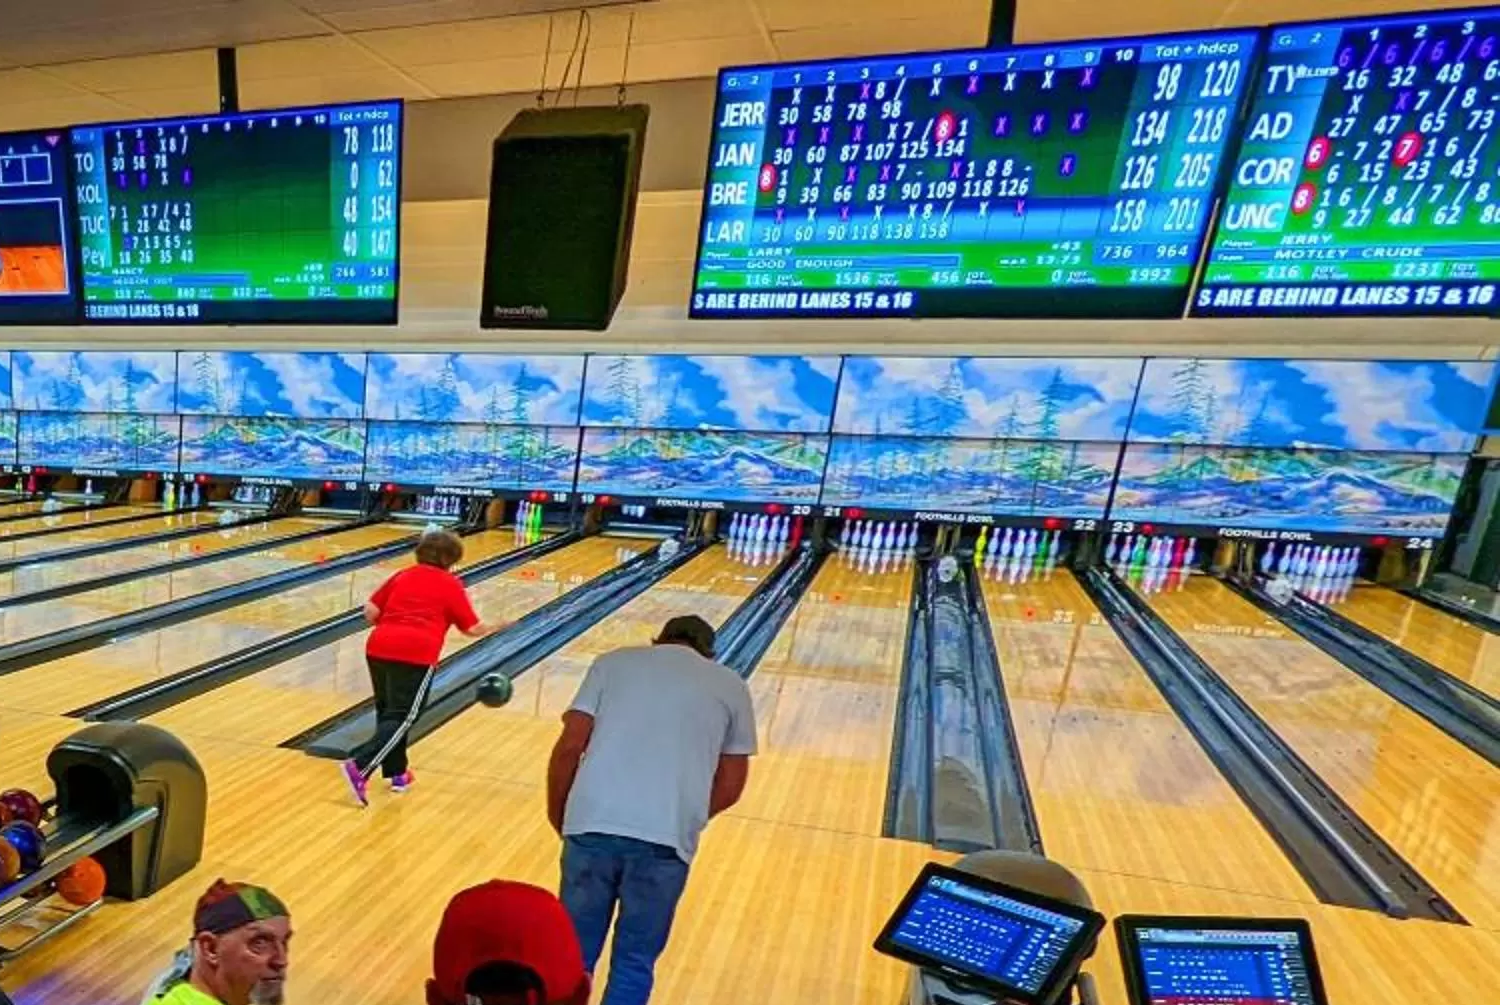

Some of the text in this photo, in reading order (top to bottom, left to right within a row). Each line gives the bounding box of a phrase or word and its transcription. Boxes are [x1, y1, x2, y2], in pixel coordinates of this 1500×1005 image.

[1155, 42, 1239, 57] Tot hdcp
[794, 74, 801, 83] 1
[827, 71, 835, 81] 2
[861, 68, 869, 79] 3
[896, 66, 905, 76] 4
[969, 60, 977, 71] 6
[1006, 58, 1016, 69] 7
[1044, 55, 1054, 66] 8
[1115, 49, 1133, 61] 10
[1343, 63, 1464, 90] 16 32 48
[1153, 60, 1241, 100] 98 120
[1267, 65, 1297, 94] TY
[720, 101, 766, 127] JERR
[779, 101, 901, 125] 30 58 78 98
[1328, 110, 1495, 137] 27 47 65 73
[1132, 107, 1227, 147] 134 218
[1249, 112, 1293, 140] AD
[343, 124, 393, 154] 78 118
[74, 152, 94, 173] TO
[715, 143, 755, 167] JAN
[773, 139, 964, 165] 30 60 87 107 125 134
[379, 160, 393, 187] 62
[1120, 152, 1214, 190] 126 205
[1238, 159, 1294, 186] COR
[1326, 159, 1478, 183] 6 15 23 43
[77, 184, 103, 204] KOL
[710, 181, 748, 205] BRE
[776, 178, 1029, 204] 9 39 66 83 90 109 118 126
[80, 216, 106, 234] TUC
[1109, 198, 1201, 232] 158 201
[1225, 203, 1283, 229] UNC
[1312, 205, 1462, 229] 9 27 44 62
[704, 220, 744, 243] LAR
[762, 222, 949, 242] 30 60 90 118 138 158
[1280, 234, 1333, 245] JERRY
[747, 247, 793, 257] LARRY
[1101, 245, 1189, 259] 736 964
[1274, 247, 1425, 260] MOTLEY CRUDE
[746, 259, 853, 269] GOOD ENOUGH
[1128, 269, 1172, 282] 1992
[1391, 262, 1440, 277] 1231
[705, 293, 737, 309] ARE
[738, 292, 798, 309] BEHIND
[800, 292, 851, 309] LANES
[853, 292, 873, 308] 15
[875, 294, 890, 308] &
[892, 292, 913, 308] 16
[1198, 285, 1495, 307] S ARE BEHIND LANES 15 & 16
[792, 506, 811, 515] 20
[824, 507, 841, 516] 21
[914, 511, 965, 522] FOOTHILLS
[1075, 520, 1096, 531] 22
[1112, 522, 1134, 533] 23
[1218, 527, 1313, 541] FOOTHILLS BOWL
[1406, 537, 1433, 549] 24
